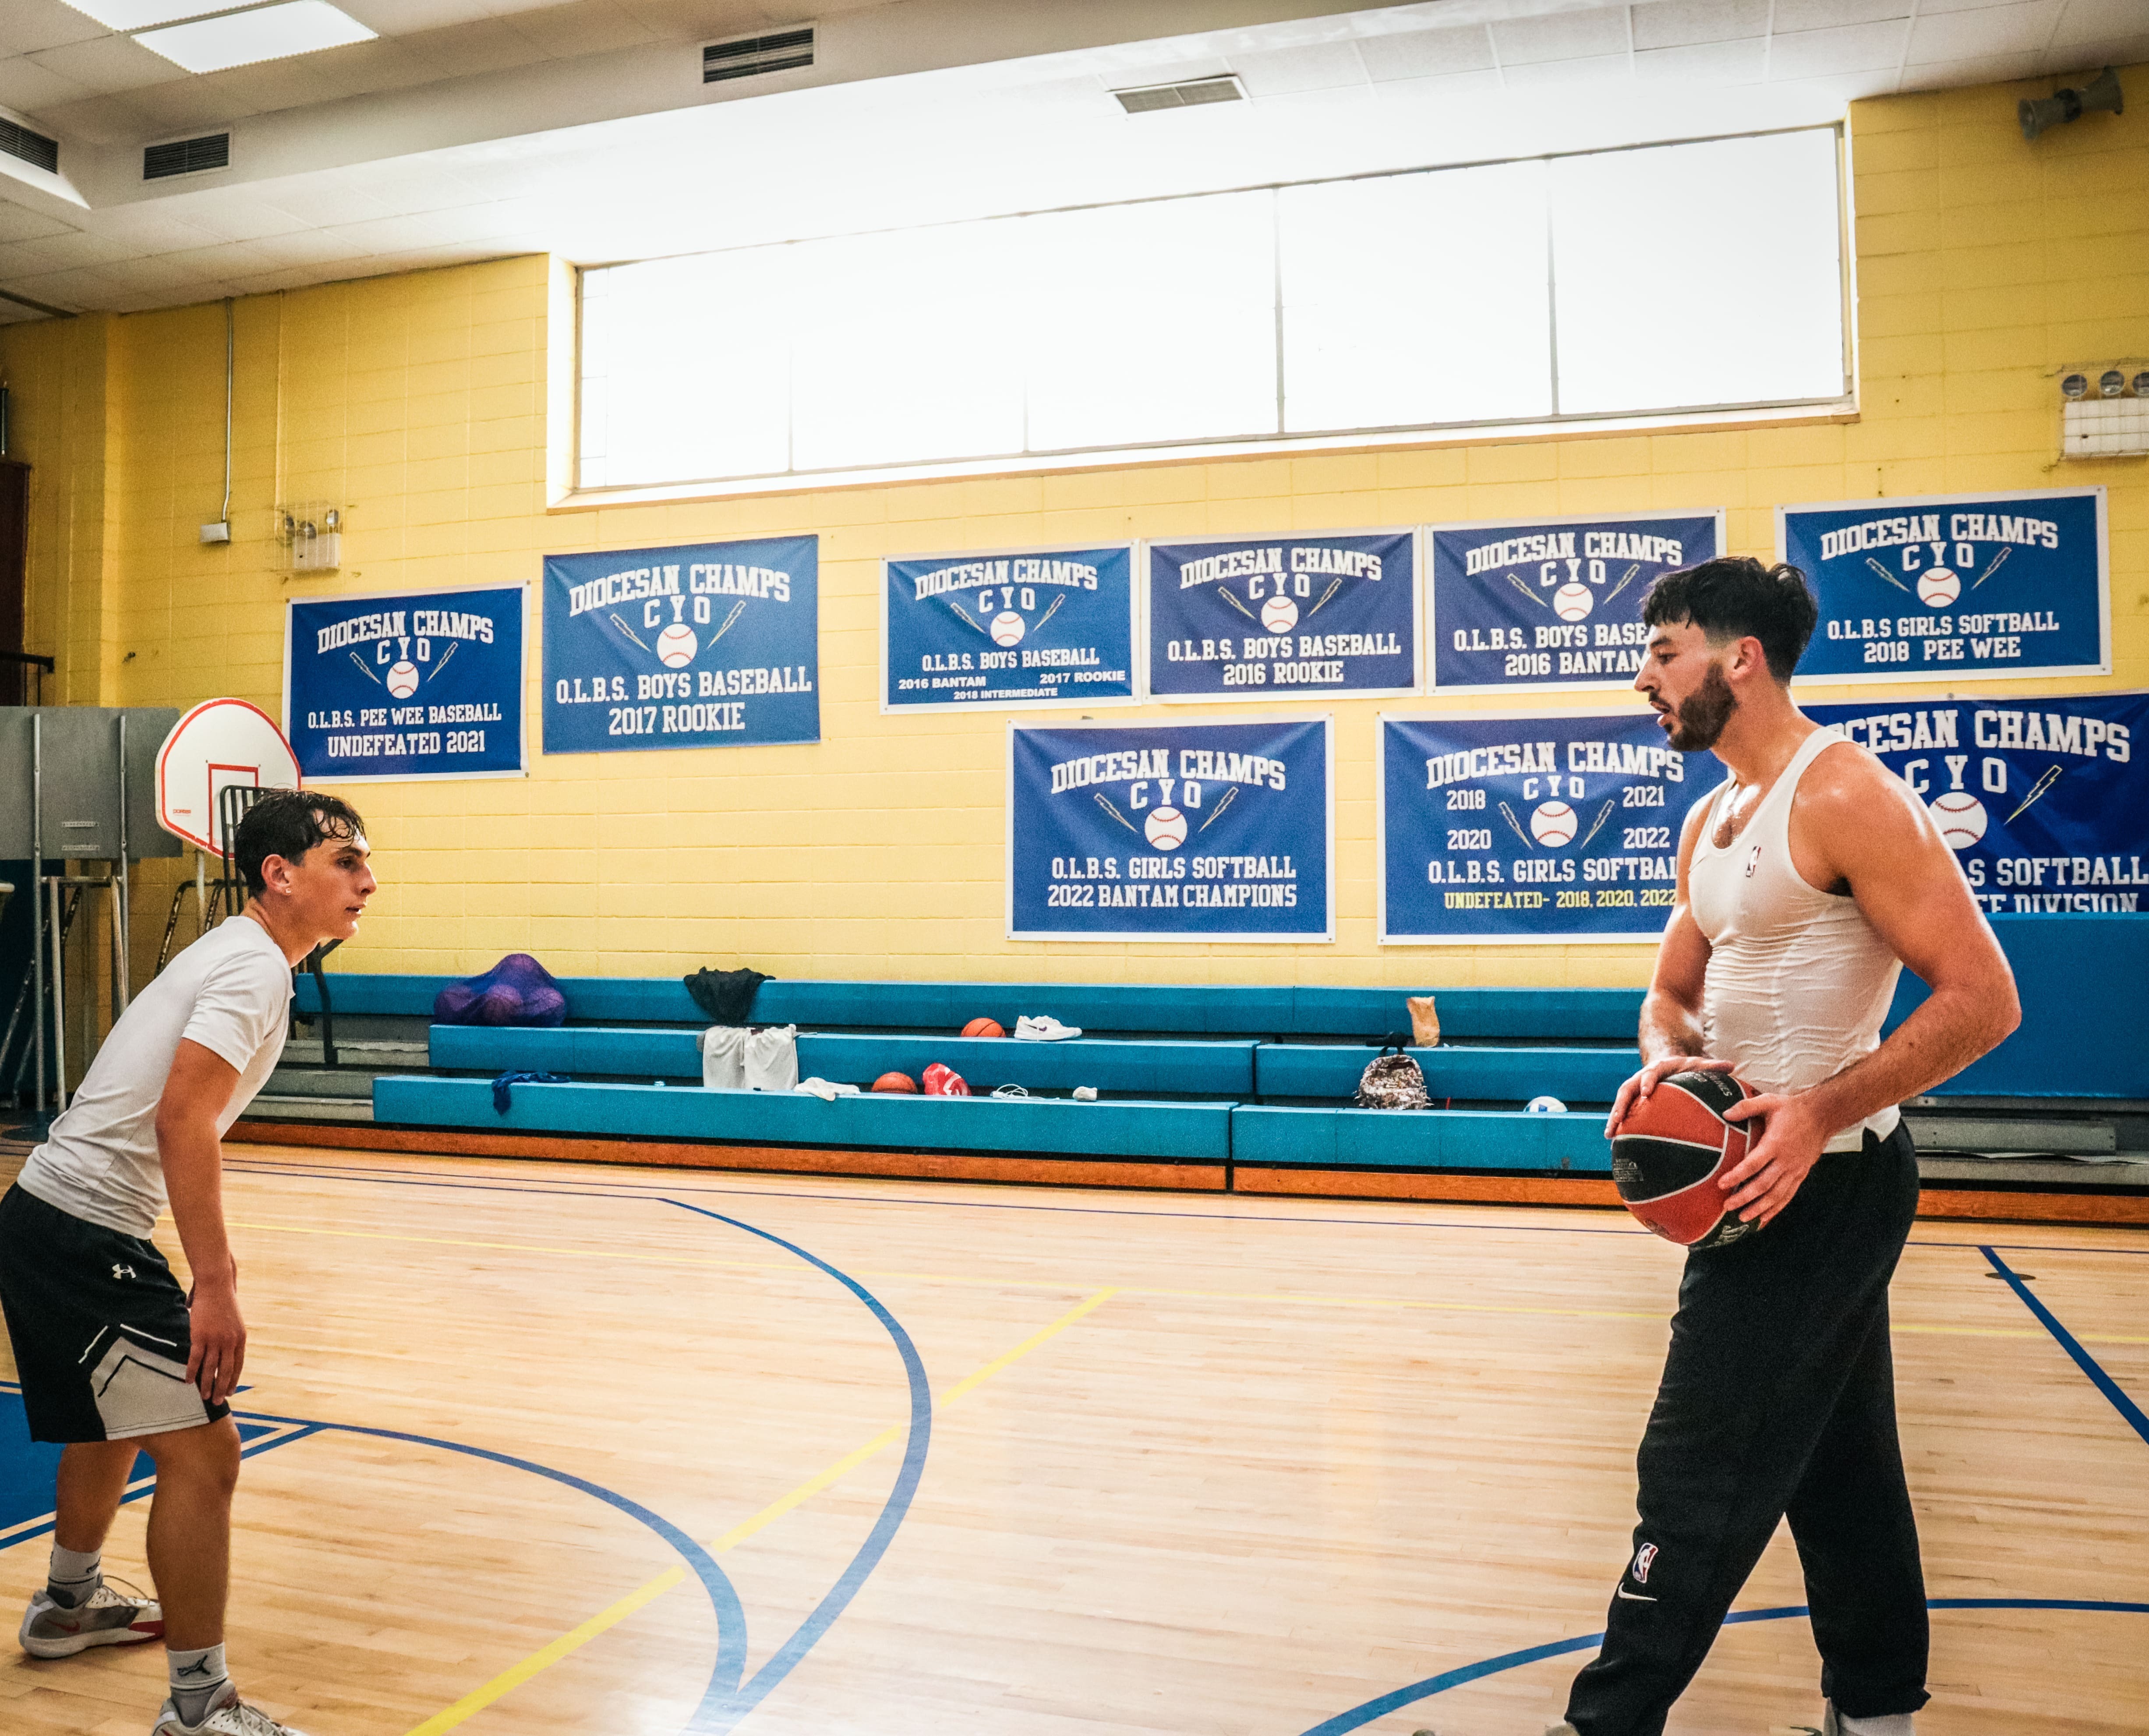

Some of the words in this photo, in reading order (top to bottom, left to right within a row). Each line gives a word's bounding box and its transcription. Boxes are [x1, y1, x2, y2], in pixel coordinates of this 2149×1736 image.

[1820, 515, 1940, 561] DIOCESAN
[1951, 514, 2057, 549] CHAMPS
[1466, 533, 1576, 576] DIOCESAN
[1585, 532, 1682, 566] CHAMPS
[915, 560, 1009, 601] DIOCESAN
[1013, 559, 1097, 590] CHAMPS
[1180, 548, 1283, 589] DIOCESAN
[1291, 548, 1381, 581] CHAMPS
[569, 565, 679, 617] DIOCESAN
[690, 564, 790, 601] CHAMPS
[318, 611, 406, 654] DIOCESAN
[414, 611, 493, 643] CHAMPS
[1454, 628, 1527, 651] O.L.B.S.
[1535, 625, 1587, 648] BOYS
[1595, 622, 1647, 646] BASE
[1827, 619, 1891, 640] O.L.B.S
[1897, 616, 1952, 636] GIRLS
[1959, 612, 2059, 634] SOFTBALL
[923, 653, 974, 671] O.L.B.S.
[980, 651, 1017, 669] BOYS
[1022, 648, 1099, 667] BASEBALL
[1168, 639, 1236, 661] O.L.B.S.
[1244, 637, 1292, 659] BOYS
[1299, 633, 1401, 657] BASEBALL
[1864, 641, 1909, 662] 2018
[1924, 639, 1964, 660] PEE
[1970, 636, 2021, 658] WEE
[1040, 673, 1071, 684] 2017
[1074, 671, 1125, 682] ROOKIE
[1223, 663, 1265, 685] 2016
[1273, 661, 1343, 683] ROOKIE
[1505, 653, 1551, 675] 2016
[556, 676, 629, 704] O.L.B.S.
[638, 673, 691, 700] BOYS
[699, 666, 812, 697] BASEBALL
[899, 679, 929, 689] 2016
[932, 676, 986, 688] BANTAM
[954, 691, 978, 700] 2018
[981, 688, 1057, 698] INTERMEDIATE
[308, 710, 355, 728] O.L.B.S.
[361, 709, 387, 726] PEE
[391, 707, 424, 725] WEE
[429, 703, 501, 724] BASEBALL
[609, 707, 657, 735] 2017
[662, 702, 745, 732] ROOKIE
[328, 736, 440, 757] UNDEFEATED
[447, 730, 485, 753] 2021
[1975, 710, 2129, 763] CHAMPS
[1051, 749, 1169, 794] DIOCESAN
[1180, 750, 1285, 790] CHAMPS
[1426, 742, 1556, 789] DIOCESAN
[1568, 742, 1683, 782] CHAMPS
[1447, 790, 1485, 810] 2018
[1623, 786, 1665, 807] 2021
[1447, 830, 1491, 849] 2020
[1624, 827, 1670, 849] 2022
[1052, 858, 1120, 879] O.L.B.S.
[1129, 857, 1185, 879] GIRLS
[1192, 856, 1296, 878] SOFTBALL
[1428, 860, 1504, 883] O.L.B.S.
[1513, 859, 1575, 882] GIRLS
[1583, 856, 1677, 881] SOFTBAL
[1997, 856, 2149, 886] SOFTBALL
[1048, 885, 1093, 906] 2022
[1098, 885, 1179, 907] BANTAM
[1183, 884, 1297, 907] CHAMPIONS
[1444, 892, 1550, 909] UNDEFEATED-
